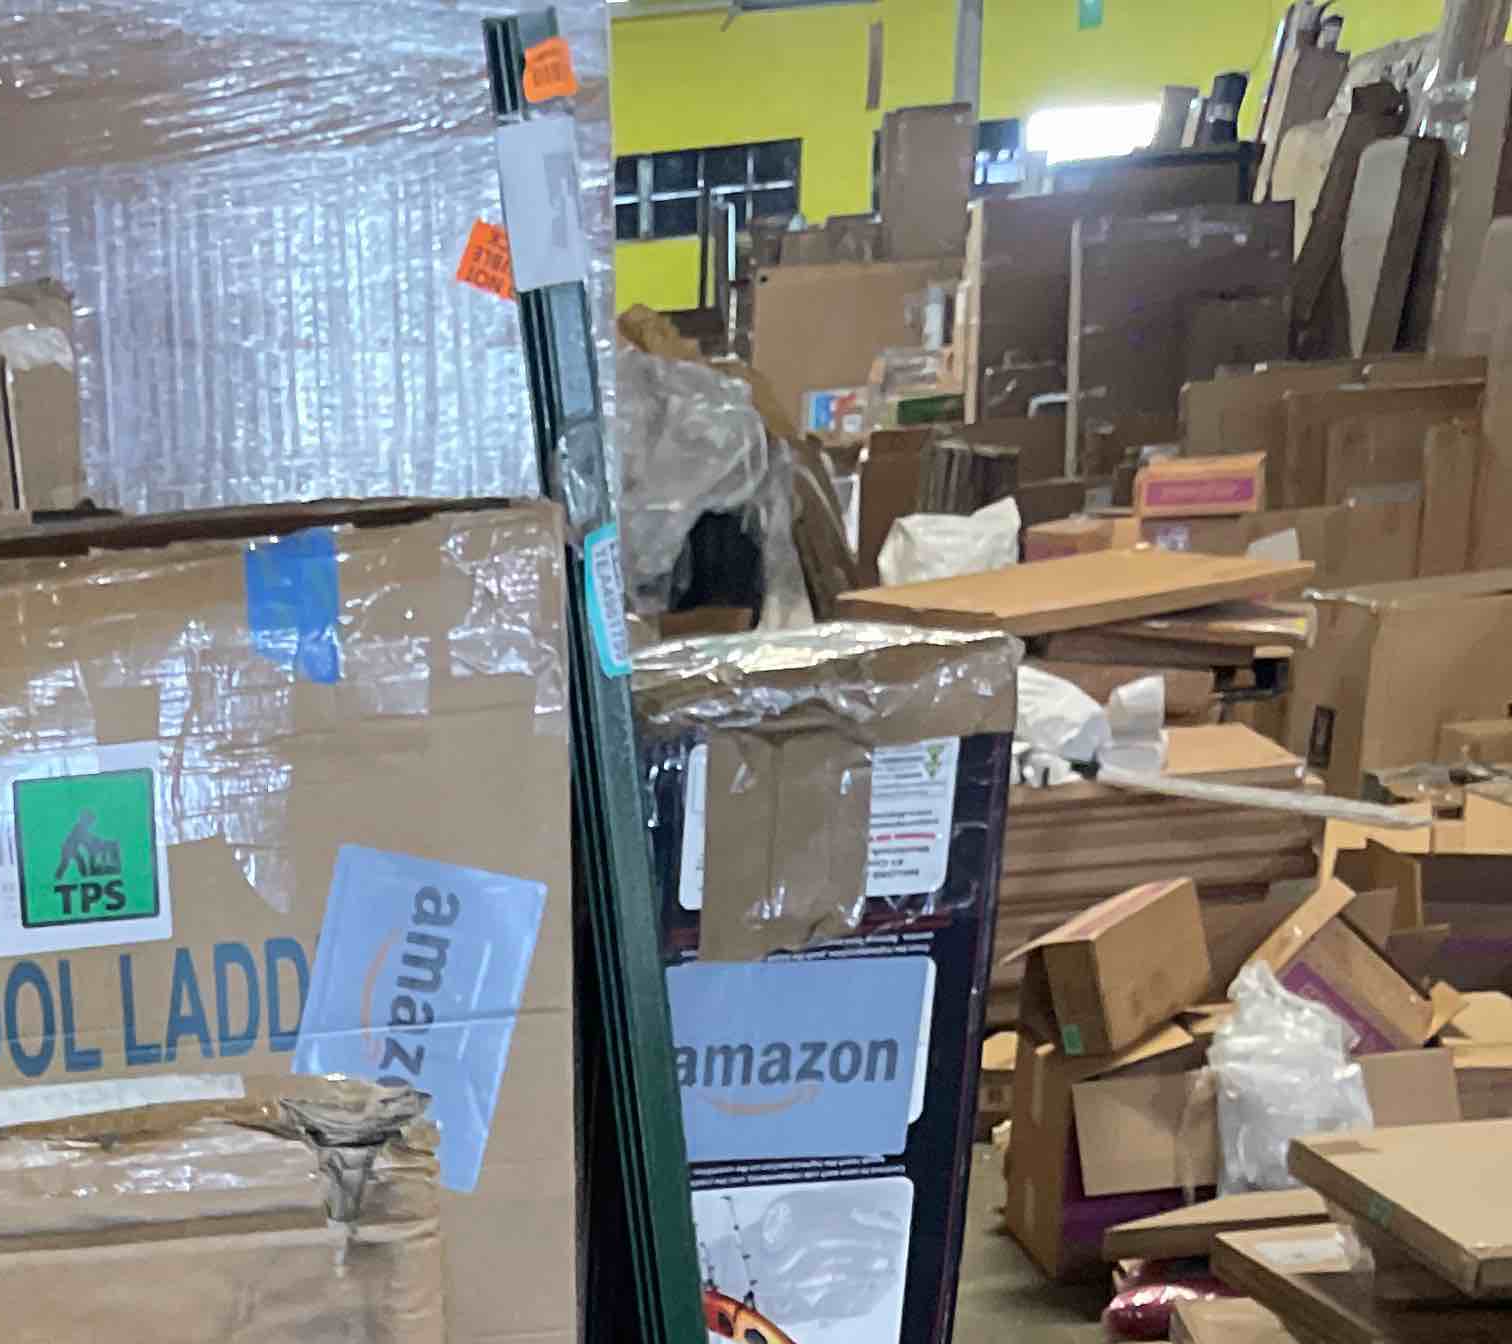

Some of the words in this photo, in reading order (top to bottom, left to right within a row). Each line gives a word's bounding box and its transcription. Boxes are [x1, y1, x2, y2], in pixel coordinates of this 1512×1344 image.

[53, 879, 126, 915] TPS
[119, 937, 318, 1067] LADD
[376, 885, 460, 1089] amaz
[674, 1036, 899, 1088] amazon
